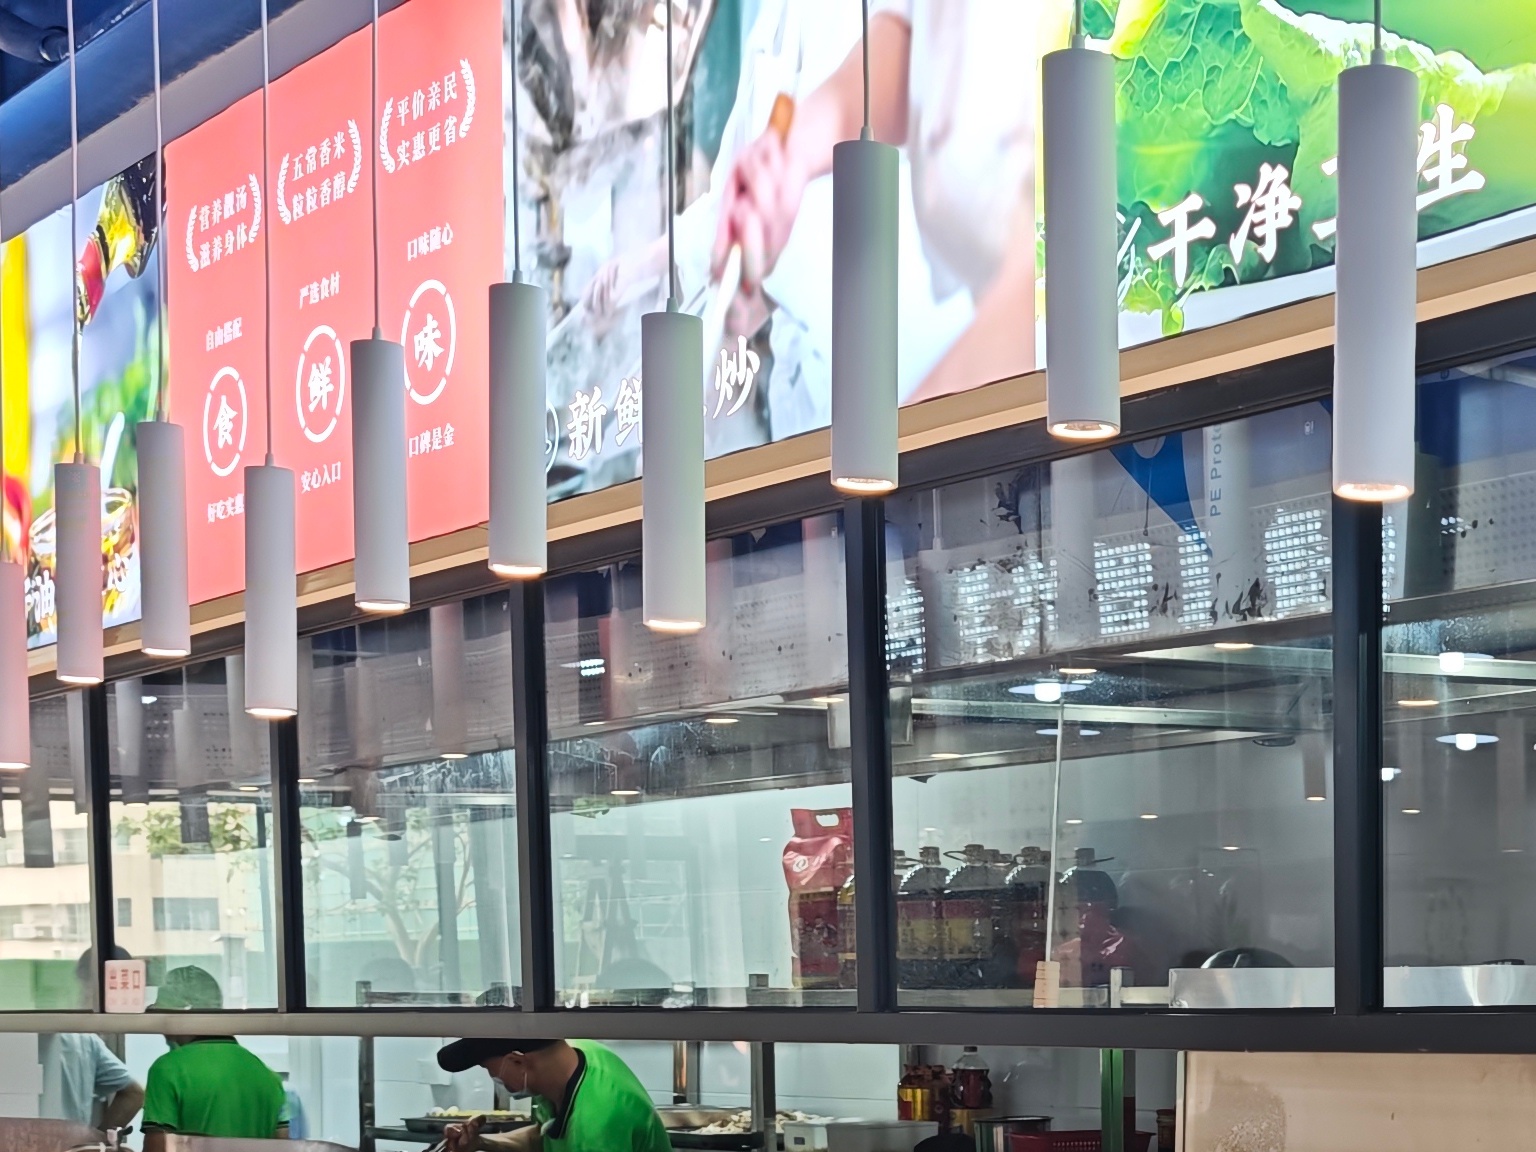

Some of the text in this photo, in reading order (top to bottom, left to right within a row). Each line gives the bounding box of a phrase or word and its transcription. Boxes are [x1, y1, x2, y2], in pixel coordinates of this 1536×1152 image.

[396, 71, 458, 127] 平价亲民
[291, 131, 346, 181] 五常香米
[396, 115, 458, 171] 实惠更省
[292, 171, 346, 221] 粒粒香醇
[1147, 103, 1486, 289] 干净生
[199, 222, 248, 269] 滋养身体
[407, 222, 454, 262] 口味随心
[299, 271, 341, 310] 严选食材
[205, 317, 242, 351] 自由搭配
[413, 313, 445, 371] 味
[307, 356, 335, 412] 鲜
[567, 334, 761, 460] 新鲜炒
[212, 395, 238, 449] 食
[408, 423, 455, 458] 口碑是金
[301, 461, 342, 494] 安心入口
